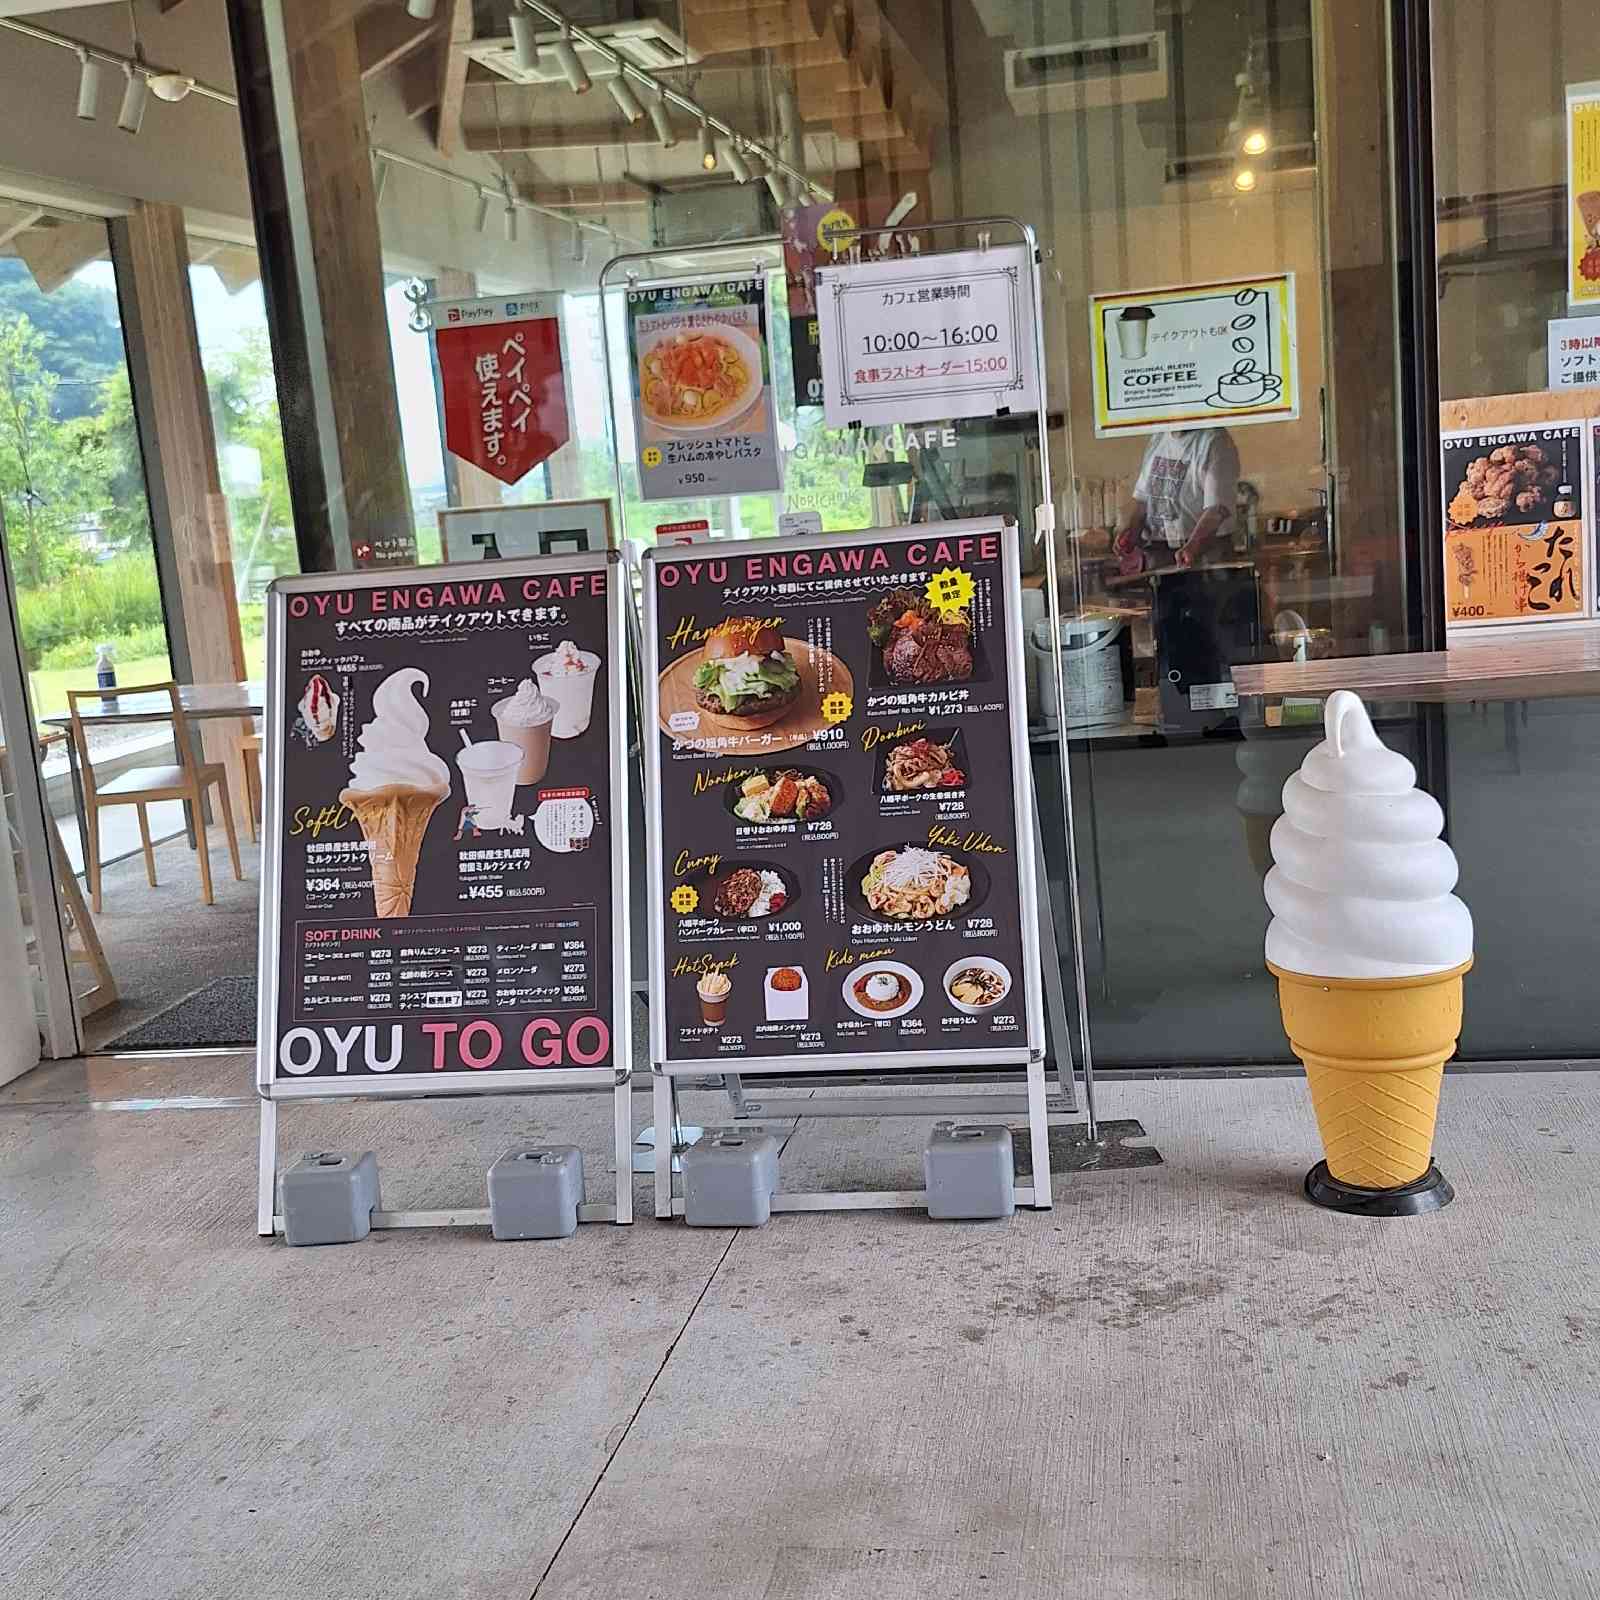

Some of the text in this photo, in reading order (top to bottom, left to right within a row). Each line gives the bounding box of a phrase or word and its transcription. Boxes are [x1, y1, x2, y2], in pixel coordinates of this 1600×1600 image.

[629, 291, 657, 303] OYU
[663, 284, 721, 299] ENGAWA
[882, 285, 970, 306] カフェ営業時間
[502, 332, 531, 432] ペイペイ
[1123, 370, 1198, 386] COFFEE
[475, 353, 507, 465] 使えます。
[667, 437, 751, 451] フレッシュトマトと
[1444, 428, 1579, 450] OYU ENGAWA CAFE
[667, 447, 761, 464] 生ハムの冷やしパスタ
[659, 537, 998, 586] OYU ENGAWA CAFE
[289, 574, 607, 618] OYU ENGAWA CAFE
[1452, 605, 1485, 617] ¥400
[335, 606, 567, 634] すべての商品がテイクアウトできます。
[867, 690, 969, 707] かづの短角牛カルビ丼
[929, 704, 963, 716] ¥1,273
[672, 728, 844, 750] かづの短角牛バーガー ¥910
[939, 802, 965, 811] ¥728
[807, 821, 833, 831] ¥728
[306, 878, 341, 891] ¥364
[468, 886, 504, 899] ¥455
[305, 929, 338, 941] SOFT
[341, 928, 382, 940] DRINK
[768, 921, 801, 931] ¥1,000
[851, 918, 993, 935] おおゆホルモンうどん ¥728
[279, 1016, 610, 1075] OYU TO GO
